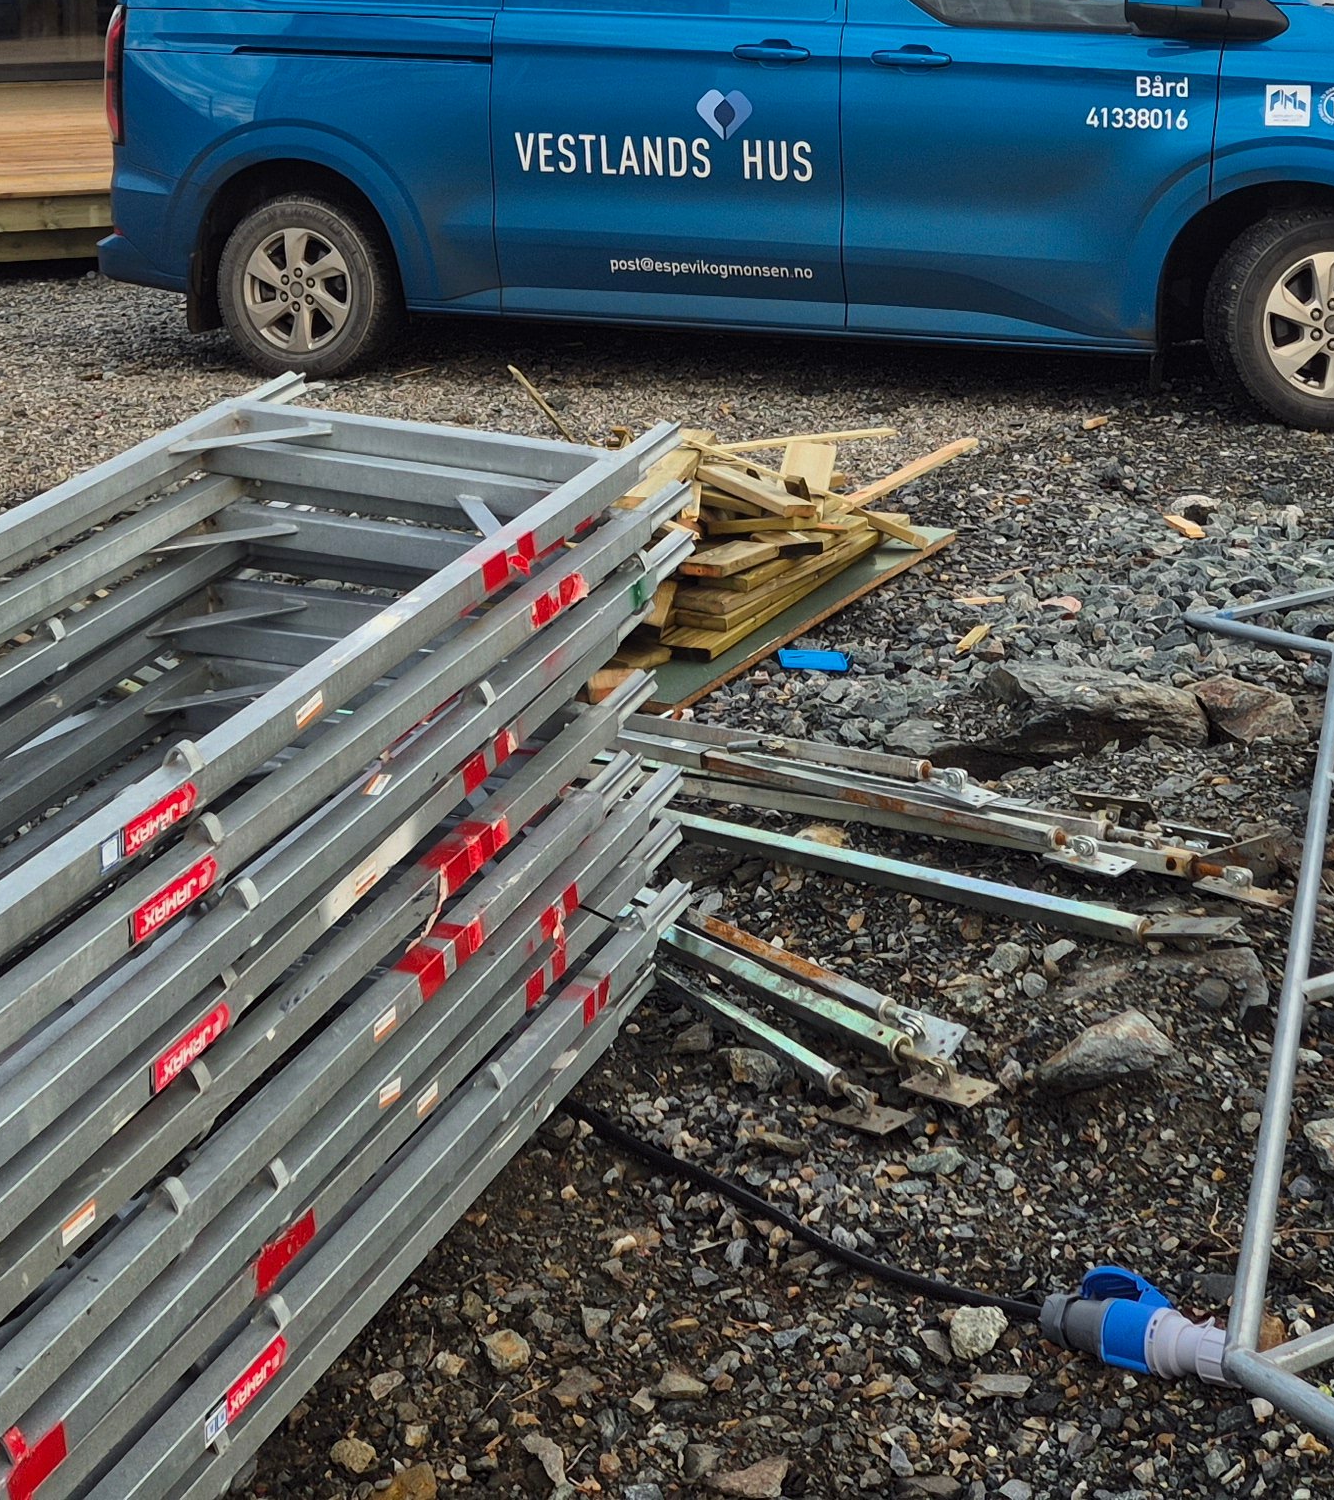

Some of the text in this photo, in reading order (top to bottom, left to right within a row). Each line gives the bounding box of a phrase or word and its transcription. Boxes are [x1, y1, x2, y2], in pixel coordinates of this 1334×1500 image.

[1135, 75, 1189, 98] Bård
[1086, 106, 1189, 130] 41338016
[514, 131, 814, 182] VESTLANDS HUS
[610, 256, 814, 280] post@espevikogmonsen.no
[142, 877, 198, 932] JAMAX
[162, 1024, 212, 1080] JAMAX
